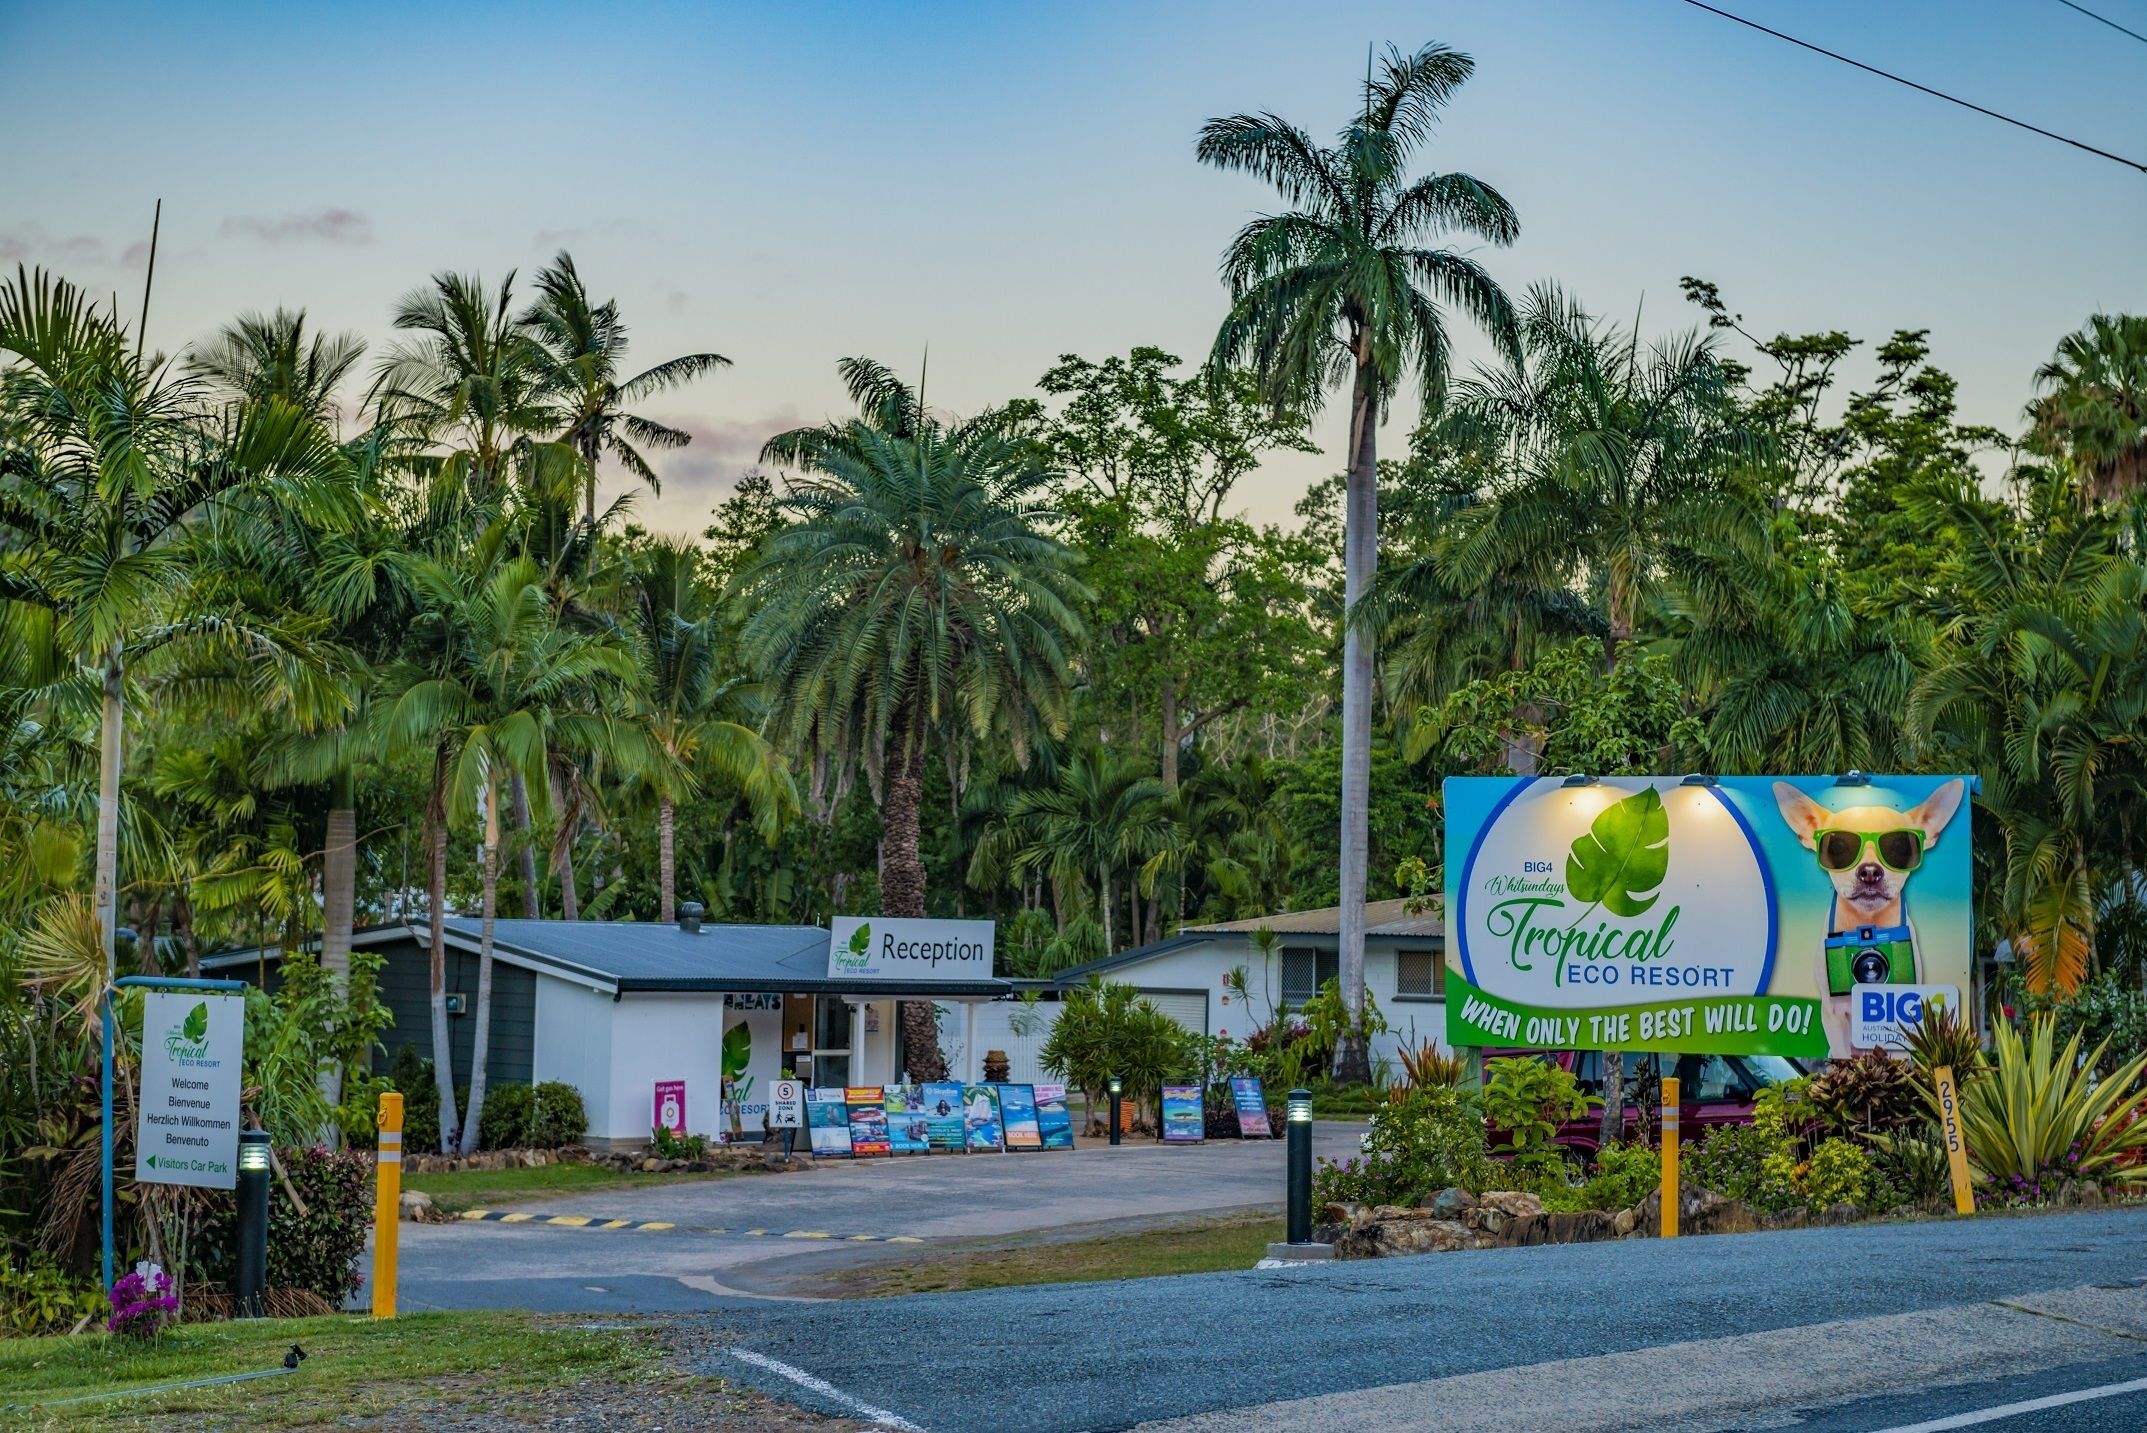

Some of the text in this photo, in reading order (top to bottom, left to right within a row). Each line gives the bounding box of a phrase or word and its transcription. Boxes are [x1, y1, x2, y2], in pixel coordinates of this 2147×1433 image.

[1524, 861, 1553, 873] BIG4
[1484, 875, 1565, 898] Whitsundays
[882, 933, 984, 968] Reception
[1487, 898, 1681, 988] Tropical
[832, 950, 871, 975] Tropical
[1568, 964, 1735, 988] ECO RESORT
[1460, 993, 1813, 1046] WHEN ONLY THE BEST WILL DO!
[164, 1036, 209, 1067] Tropical
[181, 1059, 220, 1069] ECO RESORT
[171, 1077, 209, 1091] Welcome
[783, 1087, 789, 1096] 5
[168, 1095, 211, 1110] Bienvenue
[147, 1113, 231, 1130] Herzlich Willkommen
[1940, 1081, 1959, 1153] 2955
[166, 1133, 209, 1147] Benvenuto
[158, 1157, 228, 1174] Visitors Car Park
